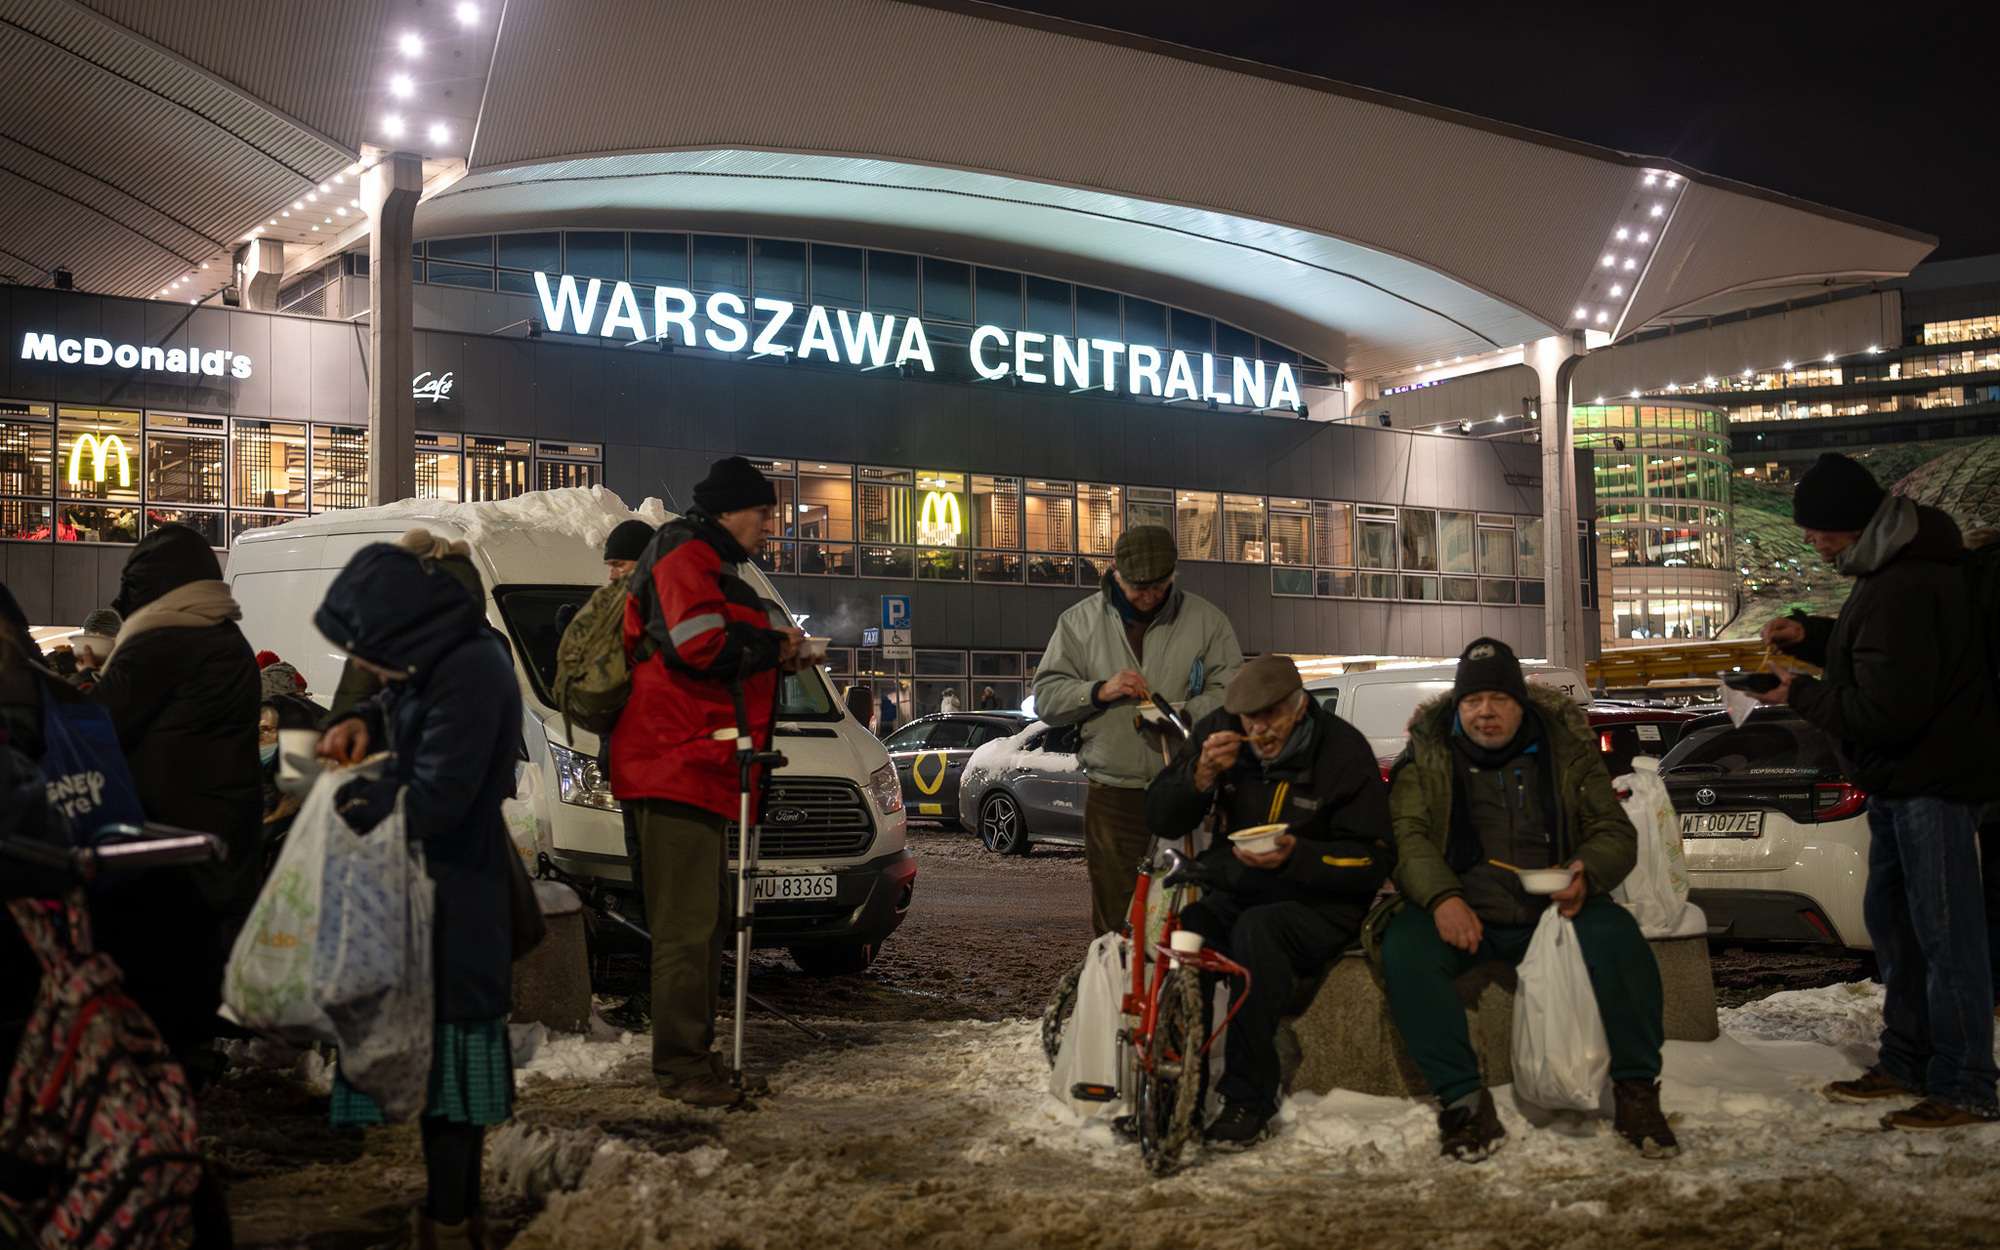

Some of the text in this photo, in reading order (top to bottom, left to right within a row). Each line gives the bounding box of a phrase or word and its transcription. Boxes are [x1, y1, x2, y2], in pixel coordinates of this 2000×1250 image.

[534, 271, 1301, 411] WARSZAWA CENTRALNA
[21, 332, 252, 379] McDonald's
[863, 631, 879, 643] TAXI
[776, 809, 800, 821] Ford
[1682, 813, 1758, 832] WT 0077E
[782, 876, 833, 897] 8336S
